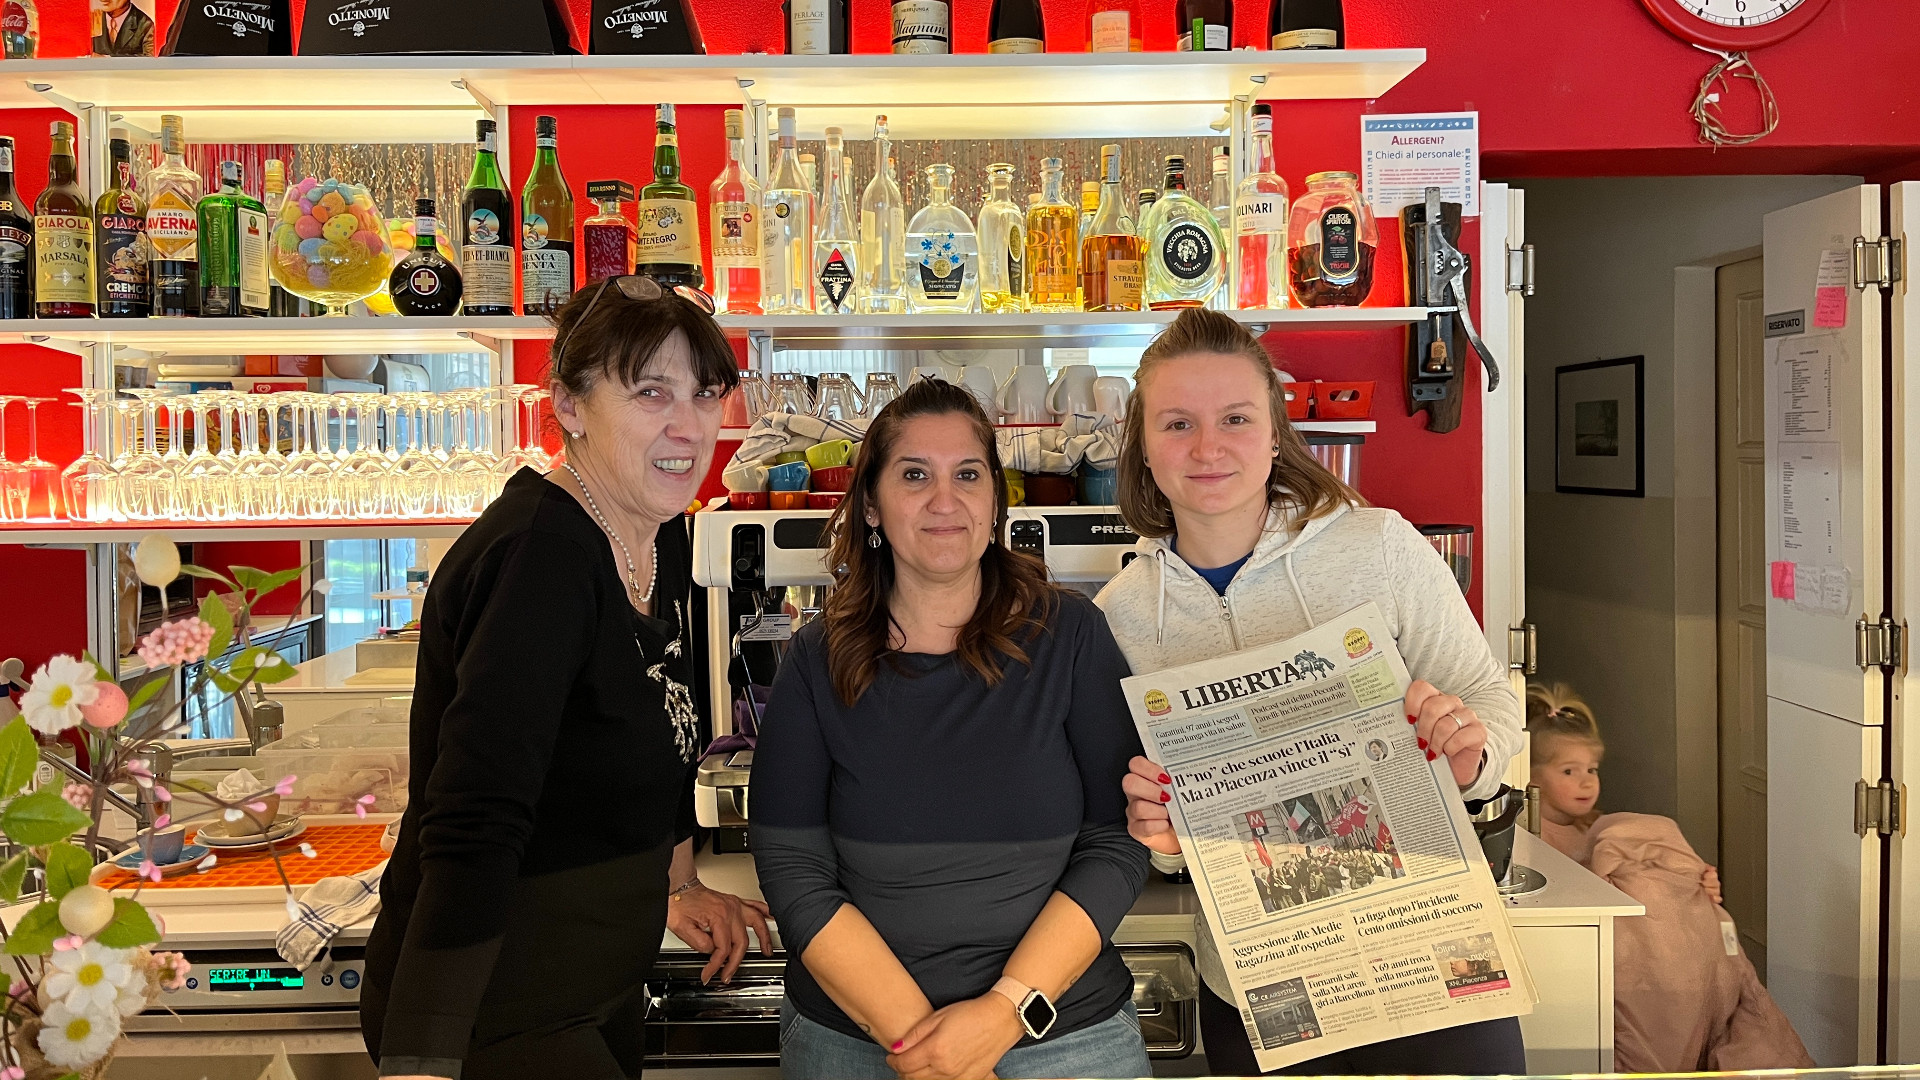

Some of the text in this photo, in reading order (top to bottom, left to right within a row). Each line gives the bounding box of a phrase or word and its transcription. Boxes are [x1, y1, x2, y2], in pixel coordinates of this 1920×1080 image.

[794, 11, 825, 19] PERLAGE
[894, 19, 946, 48] Magnum
[1391, 136, 1445, 146] ALLERGENI?
[1375, 149, 1464, 160] Chiedi al personale:
[1236, 203, 1272, 216] OLINARI
[37, 218, 90, 230] GIAROLA
[148, 217, 197, 231] AVERNA
[1166, 229, 1209, 254] VECCHIA ROMAGNA
[40, 252, 89, 268] MARSALA
[402, 256, 447, 270] UNICUM
[1768, 318, 1800, 330] RISERVATO
[1250, 700, 1279, 715] Podcast
[1278, 697, 1291, 707] sul
[1311, 680, 1345, 696] Pecorelli
[1310, 689, 1347, 707] immobile
[1158, 739, 1171, 749] per
[1224, 719, 1247, 732] salute
[1184, 723, 1194, 732] 97
[1173, 773, 1186, 788] Il
[1219, 757, 1247, 775] che
[1247, 745, 1295, 767] scuote
[1180, 786, 1203, 804] Ma
[1203, 786, 1215, 798] a
[1213, 765, 1278, 794] Piacenza
[1276, 753, 1318, 775] vince
[1317, 749, 1330, 764] il
[1352, 914, 1366, 925] La
[1364, 908, 1388, 924] fuga
[1385, 902, 1412, 919] dopo
[1356, 900, 1484, 937] Cento omissioni di soccorso
[1230, 919, 1343, 959] Aggressione alle Medie
[1234, 948, 1286, 971] Ragazzina
[1370, 953, 1431, 973] A 69 anni trova
[256, 969, 270, 979] UN
[1342, 969, 1359, 980] sale
[1373, 963, 1435, 984] nella maratona
[1461, 973, 1488, 985] Piacenza
[1377, 972, 1440, 993] un nuovo inizio
[1310, 987, 1331, 998] sulla
[1333, 986, 1375, 1003] Barcellona
